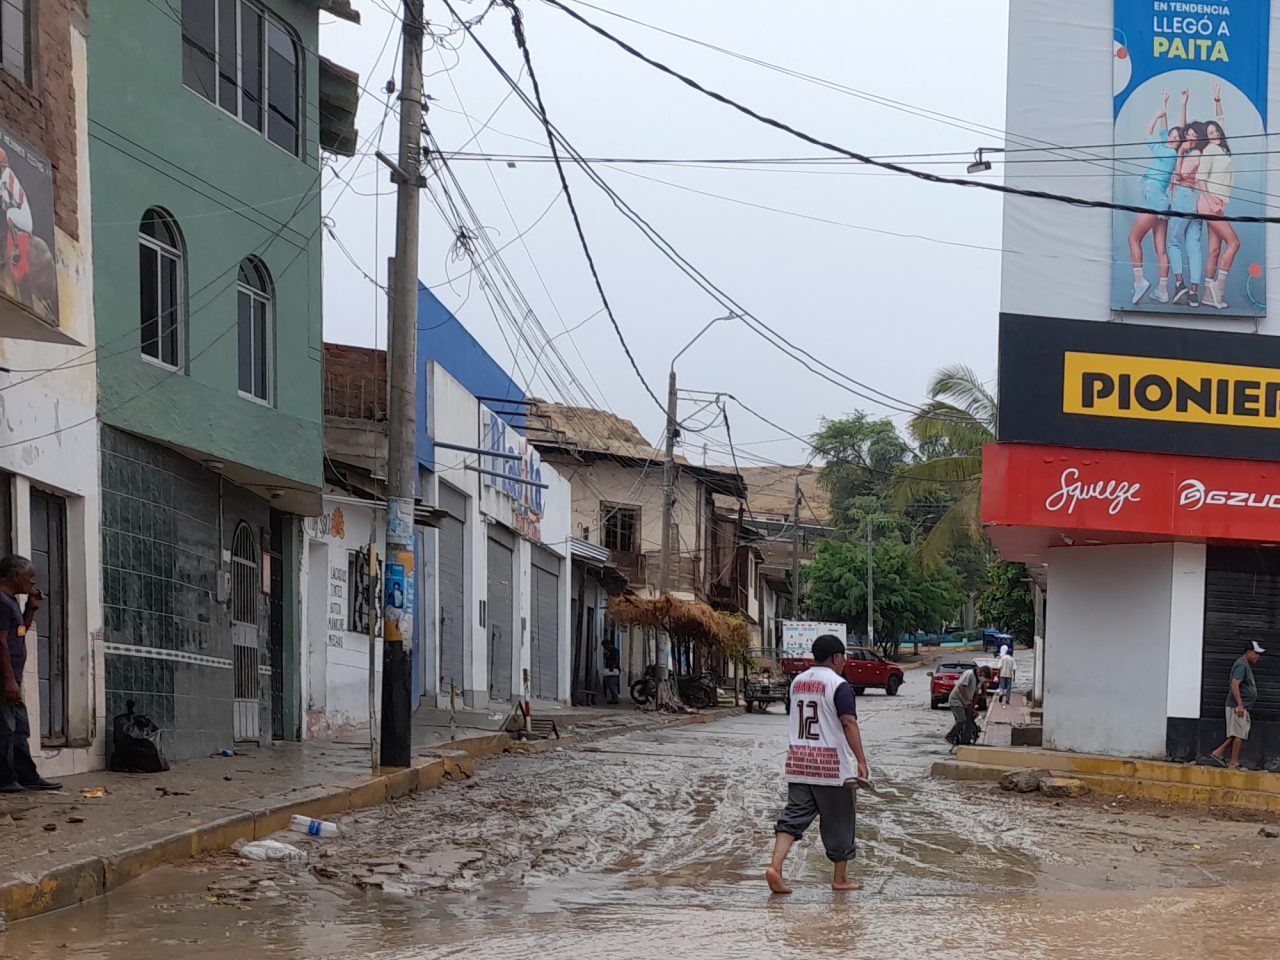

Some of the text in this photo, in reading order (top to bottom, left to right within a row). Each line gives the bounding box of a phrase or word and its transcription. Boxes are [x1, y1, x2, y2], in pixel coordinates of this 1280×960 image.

[1153, 1, 1230, 16] EN TENDENCIA
[1153, 15, 1230, 37] LLEGÓ A
[1153, 36, 1230, 62] PAITA
[1045, 467, 1141, 515] Squeeze
[797, 700, 820, 740] 12
